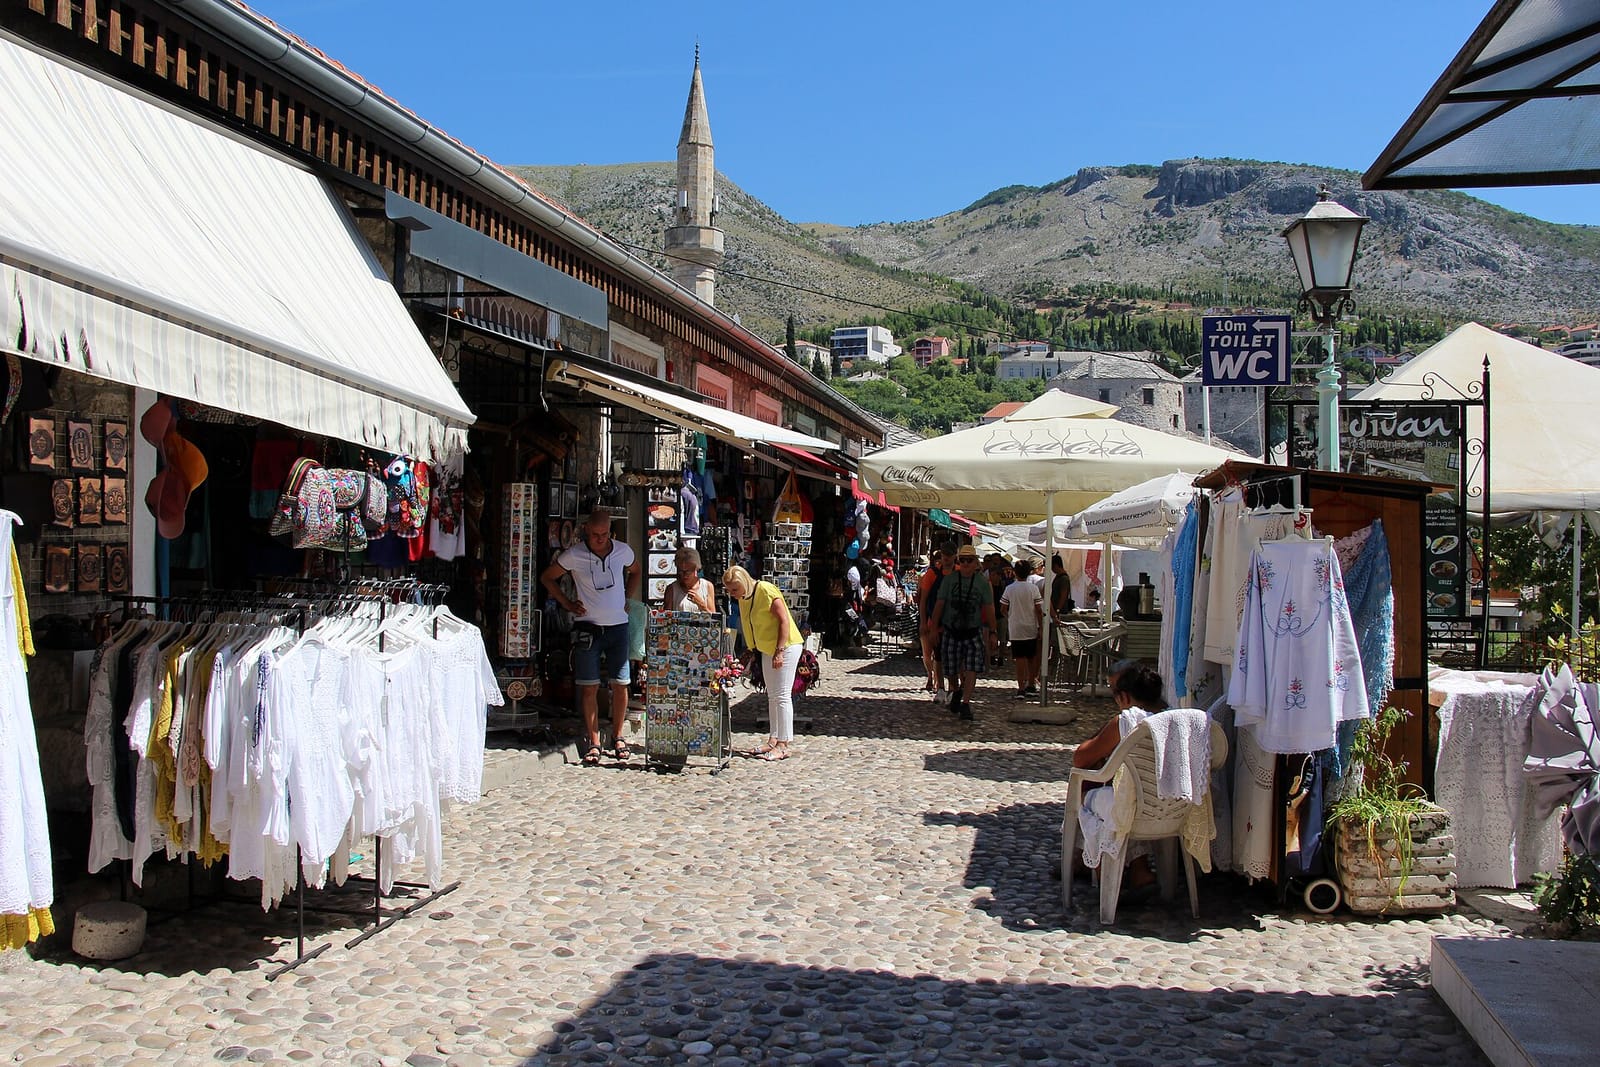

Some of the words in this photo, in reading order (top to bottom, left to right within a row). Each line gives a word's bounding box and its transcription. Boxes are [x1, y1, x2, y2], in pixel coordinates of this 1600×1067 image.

[1216, 320, 1247, 332] 10m
[1208, 335, 1276, 348] TOILET
[1209, 350, 1273, 380] WC
[1436, 439, 1452, 448] bar
